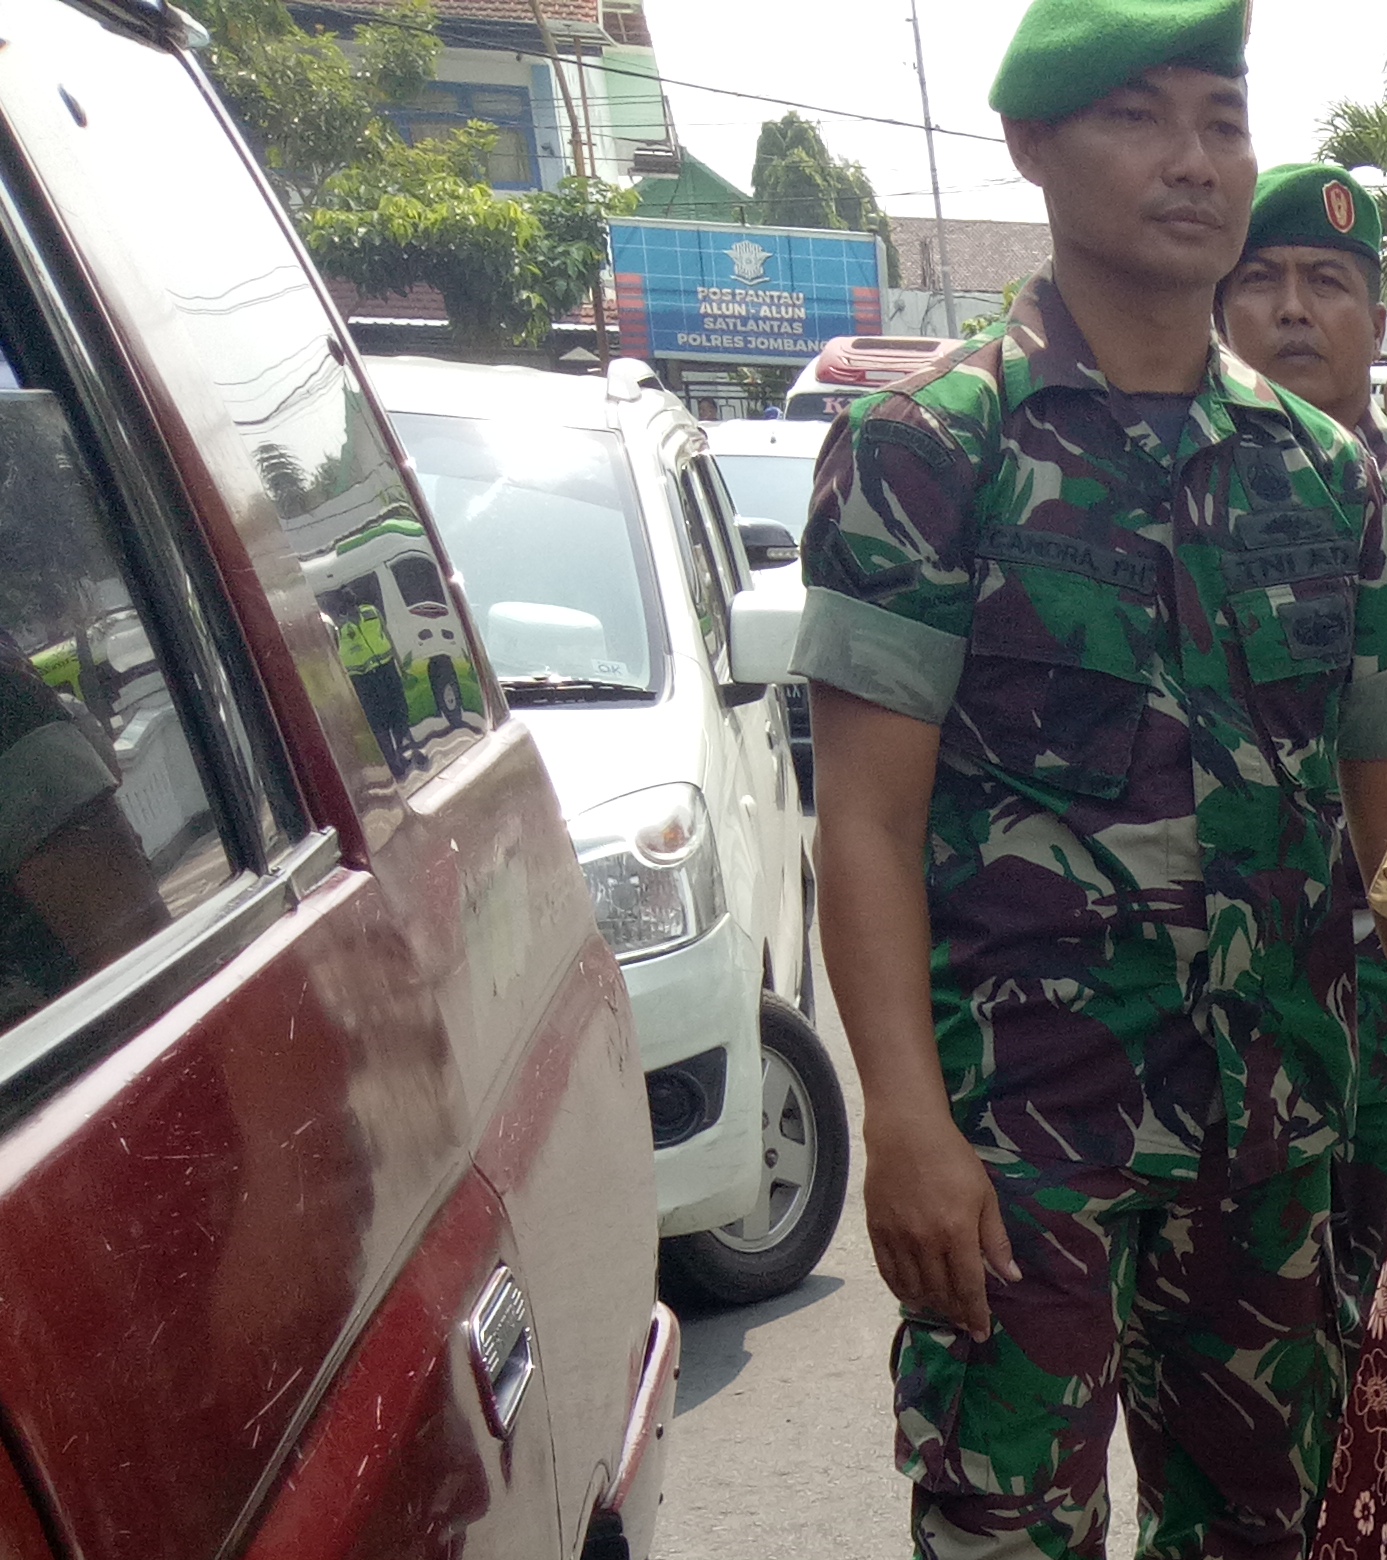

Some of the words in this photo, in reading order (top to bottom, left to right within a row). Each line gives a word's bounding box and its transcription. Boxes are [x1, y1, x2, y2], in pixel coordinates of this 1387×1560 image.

[697, 286, 732, 301] POS
[735, 288, 804, 306] PANTAU
[699, 301, 746, 316] ALUN
[759, 304, 806, 320] ALUN
[703, 317, 803, 334] SATLANTAS
[677, 332, 744, 349] POLRES
